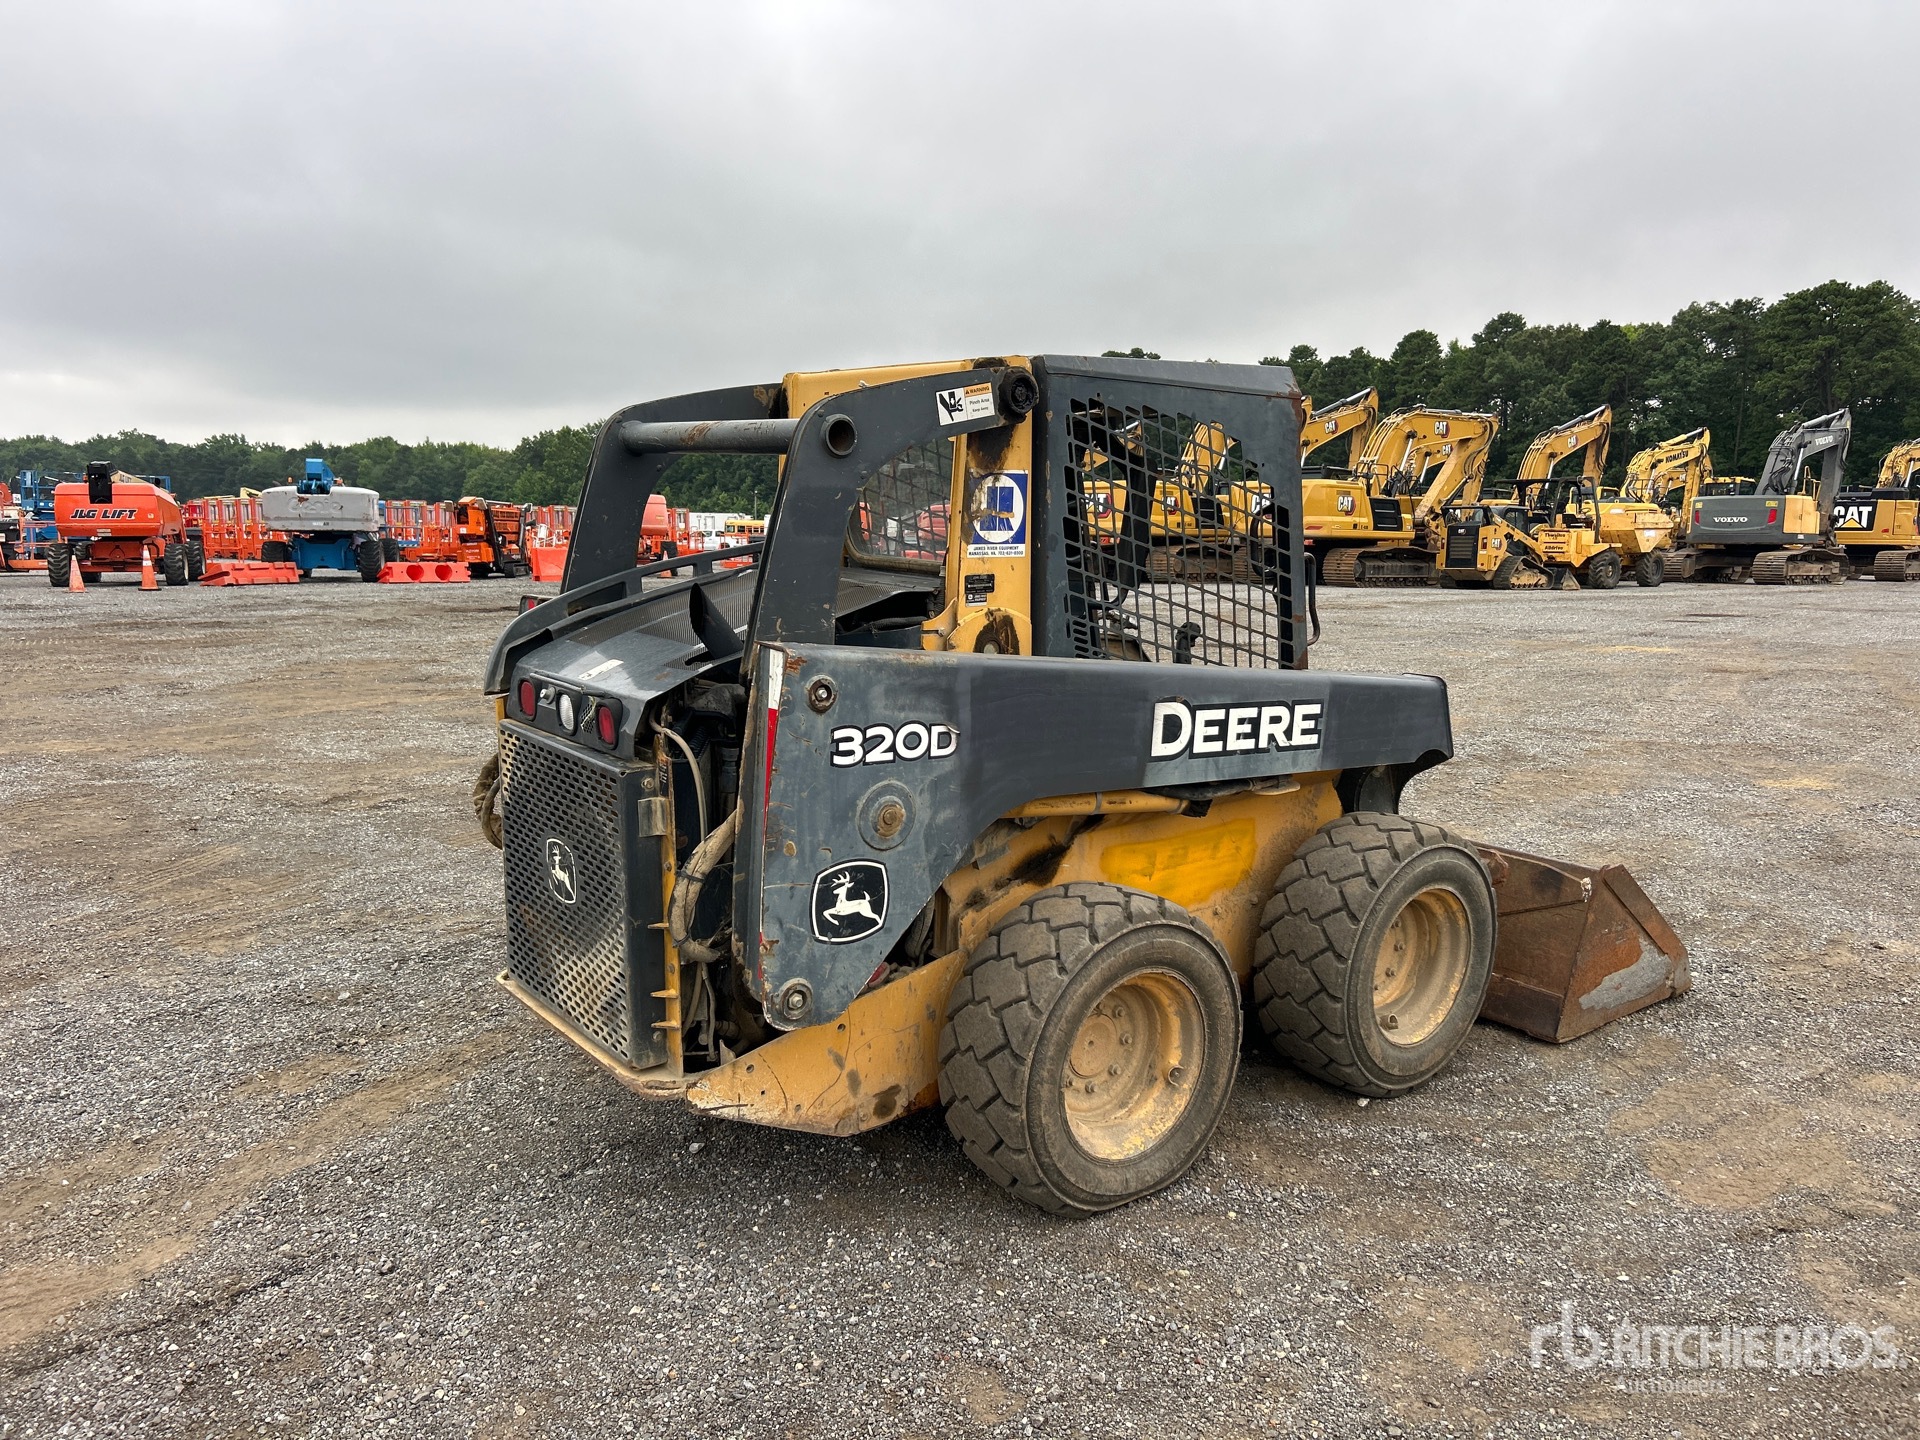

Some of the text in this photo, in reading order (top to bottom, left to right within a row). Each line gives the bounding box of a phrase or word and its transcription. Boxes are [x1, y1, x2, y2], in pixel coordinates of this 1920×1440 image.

[1325, 420, 1336, 434] CAT
[1434, 421, 1447, 435] CAT
[1567, 435, 1577, 448] CAT
[1815, 435, 1834, 446] VOLVO
[1442, 444, 1451, 455] CAT
[1665, 450, 1689, 464] KOMATSU
[1337, 496, 1353, 512] CAT
[70, 508, 138, 519] JLG LIFT
[1834, 506, 1872, 529] CAT
[1491, 537, 1501, 548] CAT
[1151, 701, 1322, 757] DEERE
[832, 722, 958, 767] 320D
